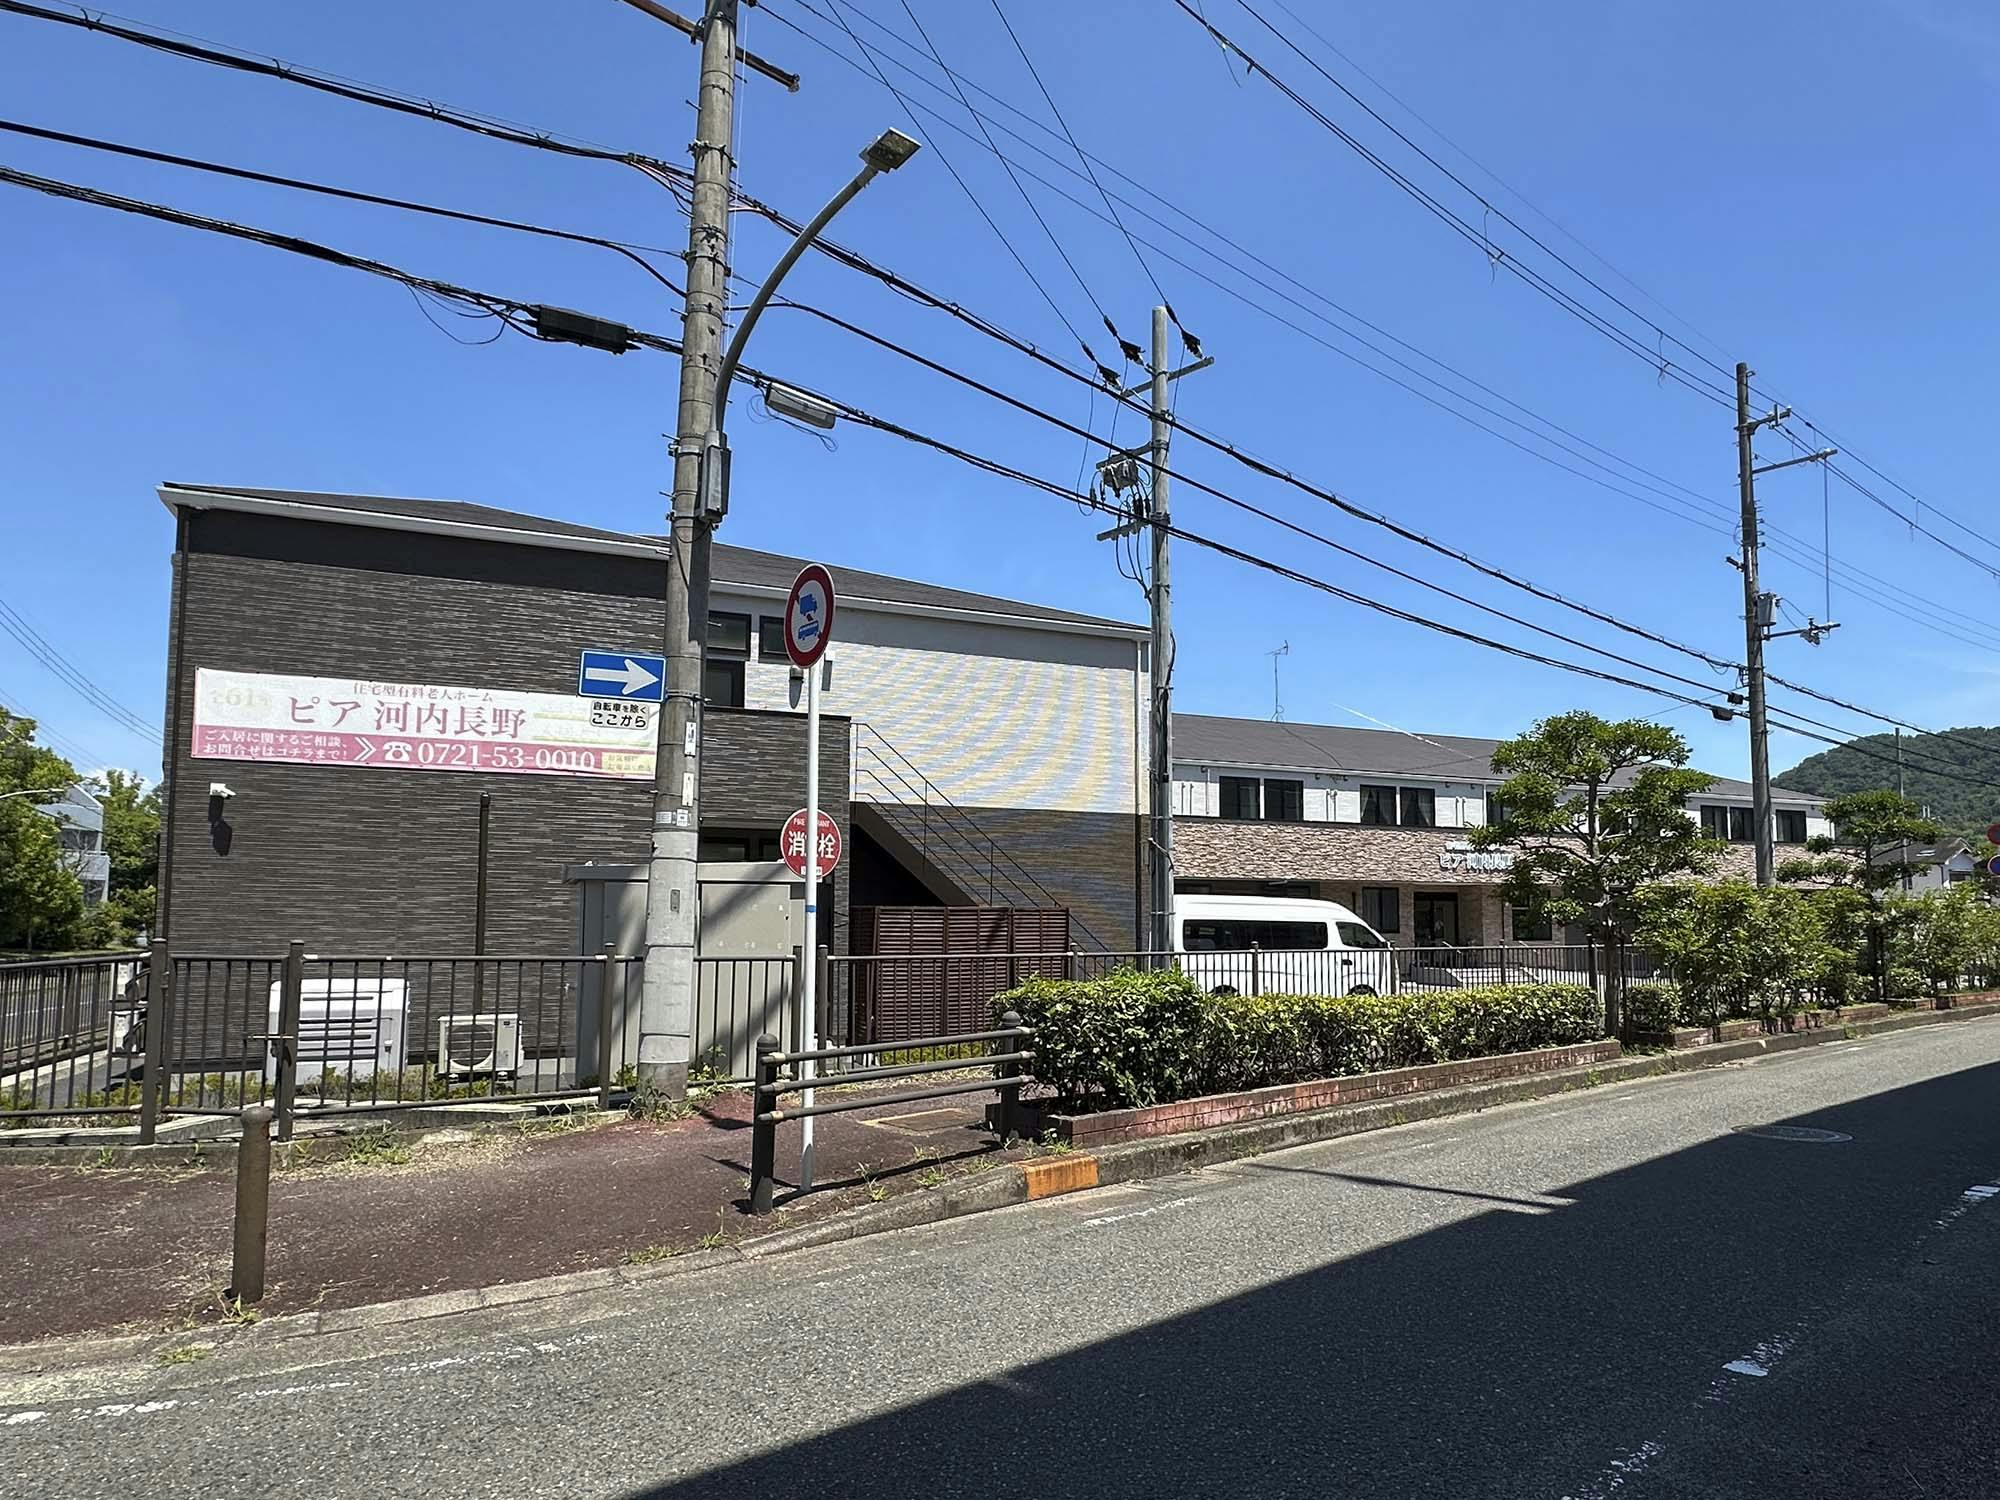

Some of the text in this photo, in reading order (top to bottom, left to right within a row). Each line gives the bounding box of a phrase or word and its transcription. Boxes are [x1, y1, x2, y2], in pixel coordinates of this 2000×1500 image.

[592, 701, 647, 715] 自転車を除く
[591, 712, 646, 728] ここから
[418, 742, 596, 769] 0721-53-0010
[788, 830, 836, 859] 消栓
